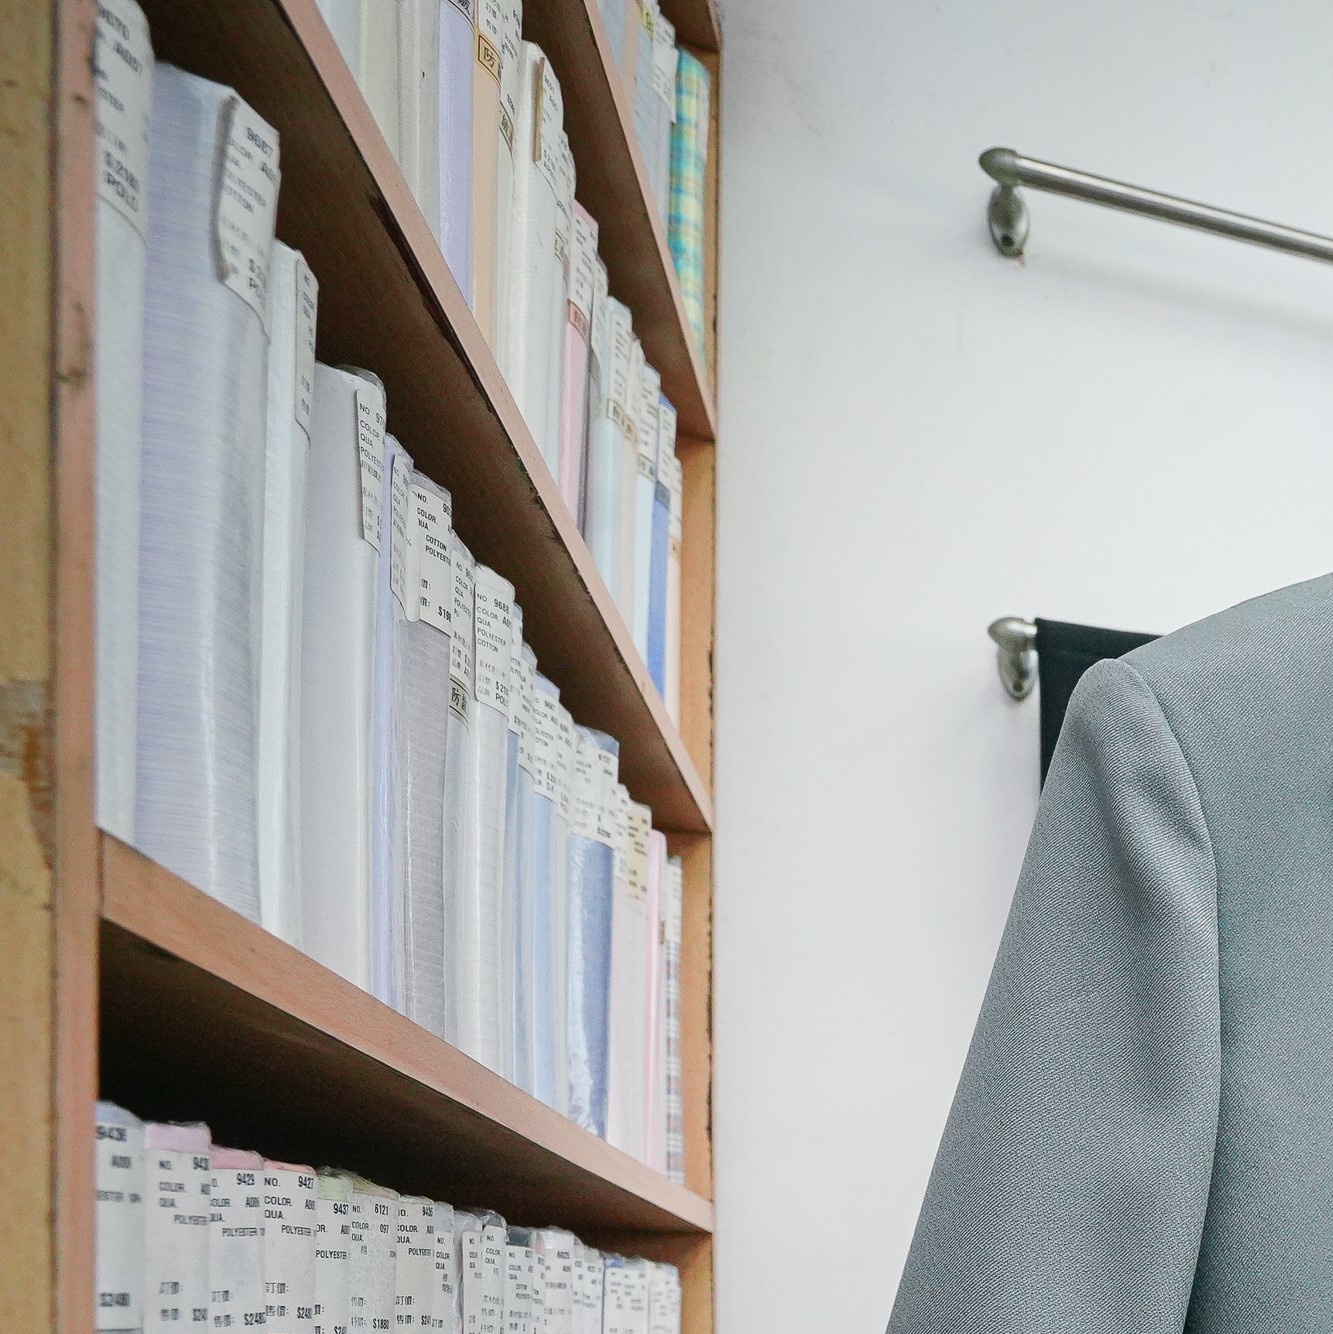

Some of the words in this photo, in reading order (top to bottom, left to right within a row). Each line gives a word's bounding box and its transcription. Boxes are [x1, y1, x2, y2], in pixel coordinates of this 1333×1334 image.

[425, 534, 447, 551] COTTON
[425, 545, 451, 566] POLYESTE
[264, 1178, 280, 1187] NO.
[264, 1196, 293, 1206] COLOR.
[264, 1210, 286, 1220] QUA.
[375, 1204, 389, 1216] 6121
